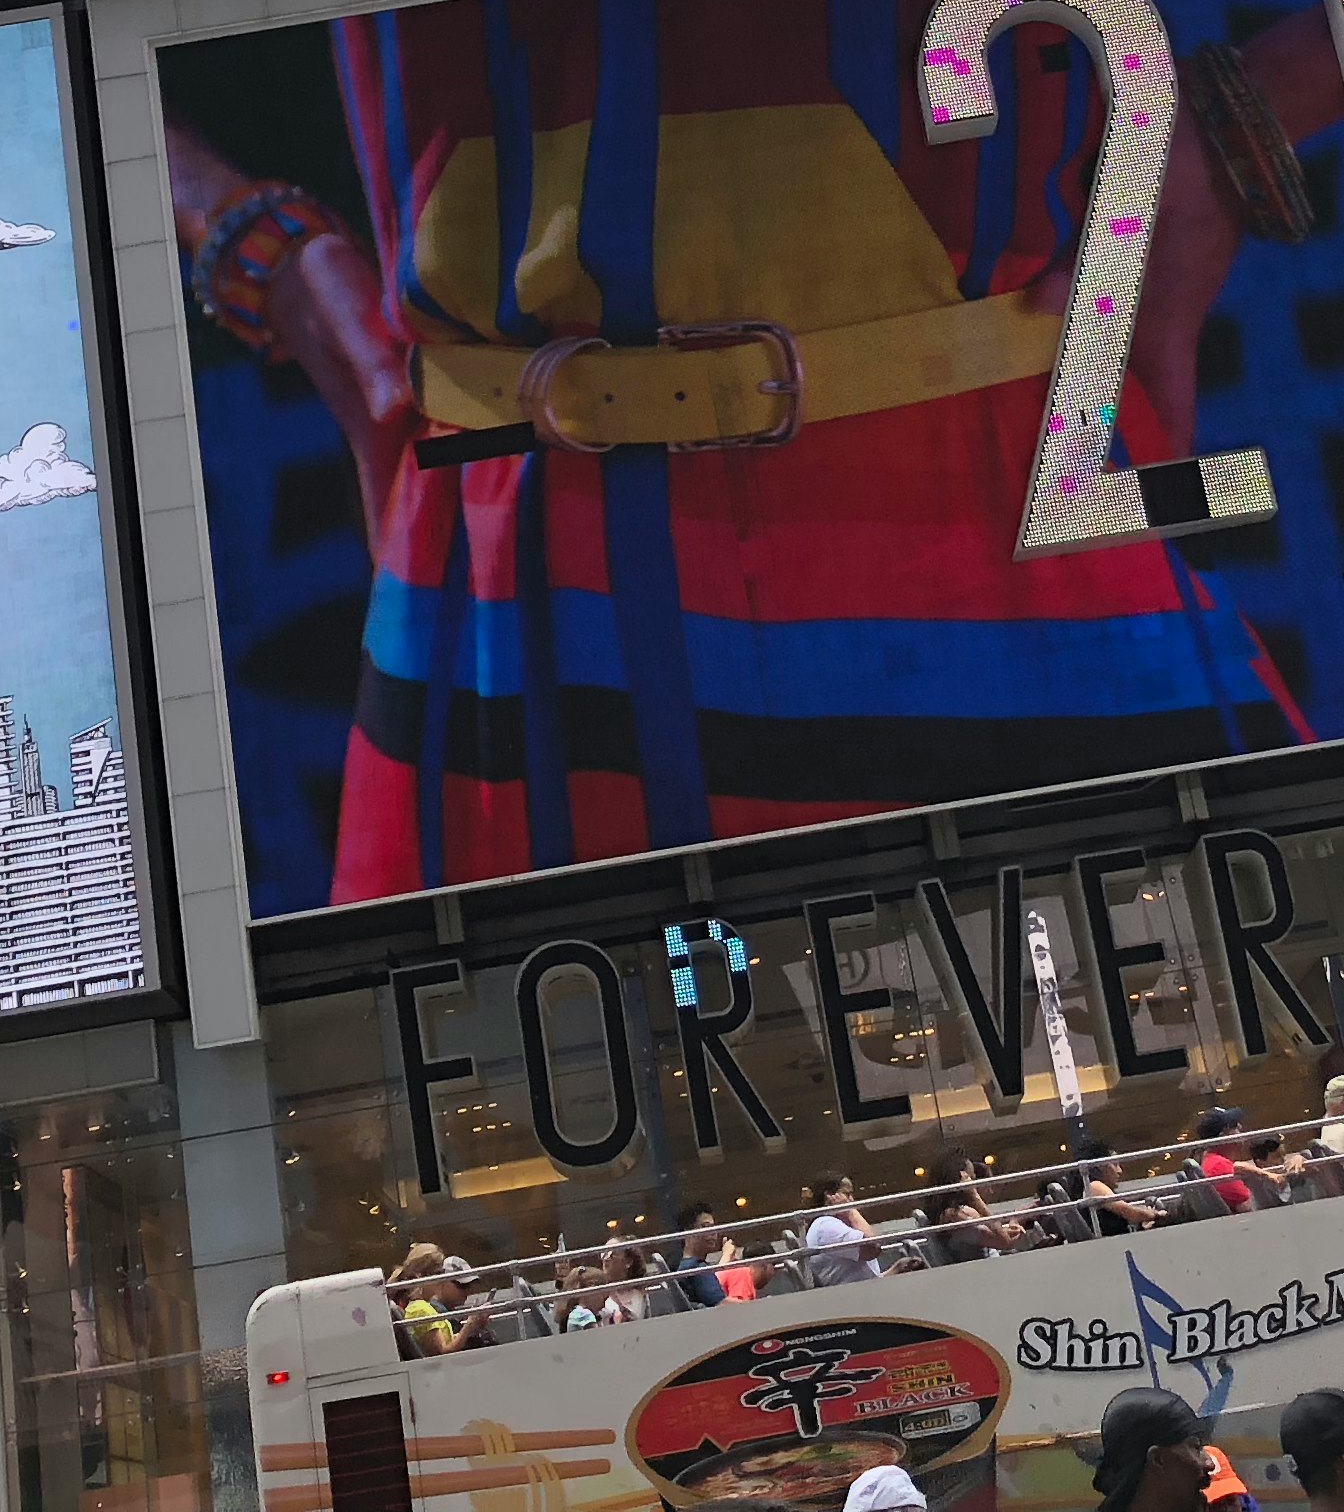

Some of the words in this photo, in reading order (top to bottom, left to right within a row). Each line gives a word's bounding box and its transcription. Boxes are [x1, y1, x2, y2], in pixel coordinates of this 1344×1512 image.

[390, 827, 1333, 1197] FOREVER
[1017, 1316, 1143, 1371] Shin
[1168, 1281, 1321, 1365] Black
[855, 1382, 974, 1415] BLACK
